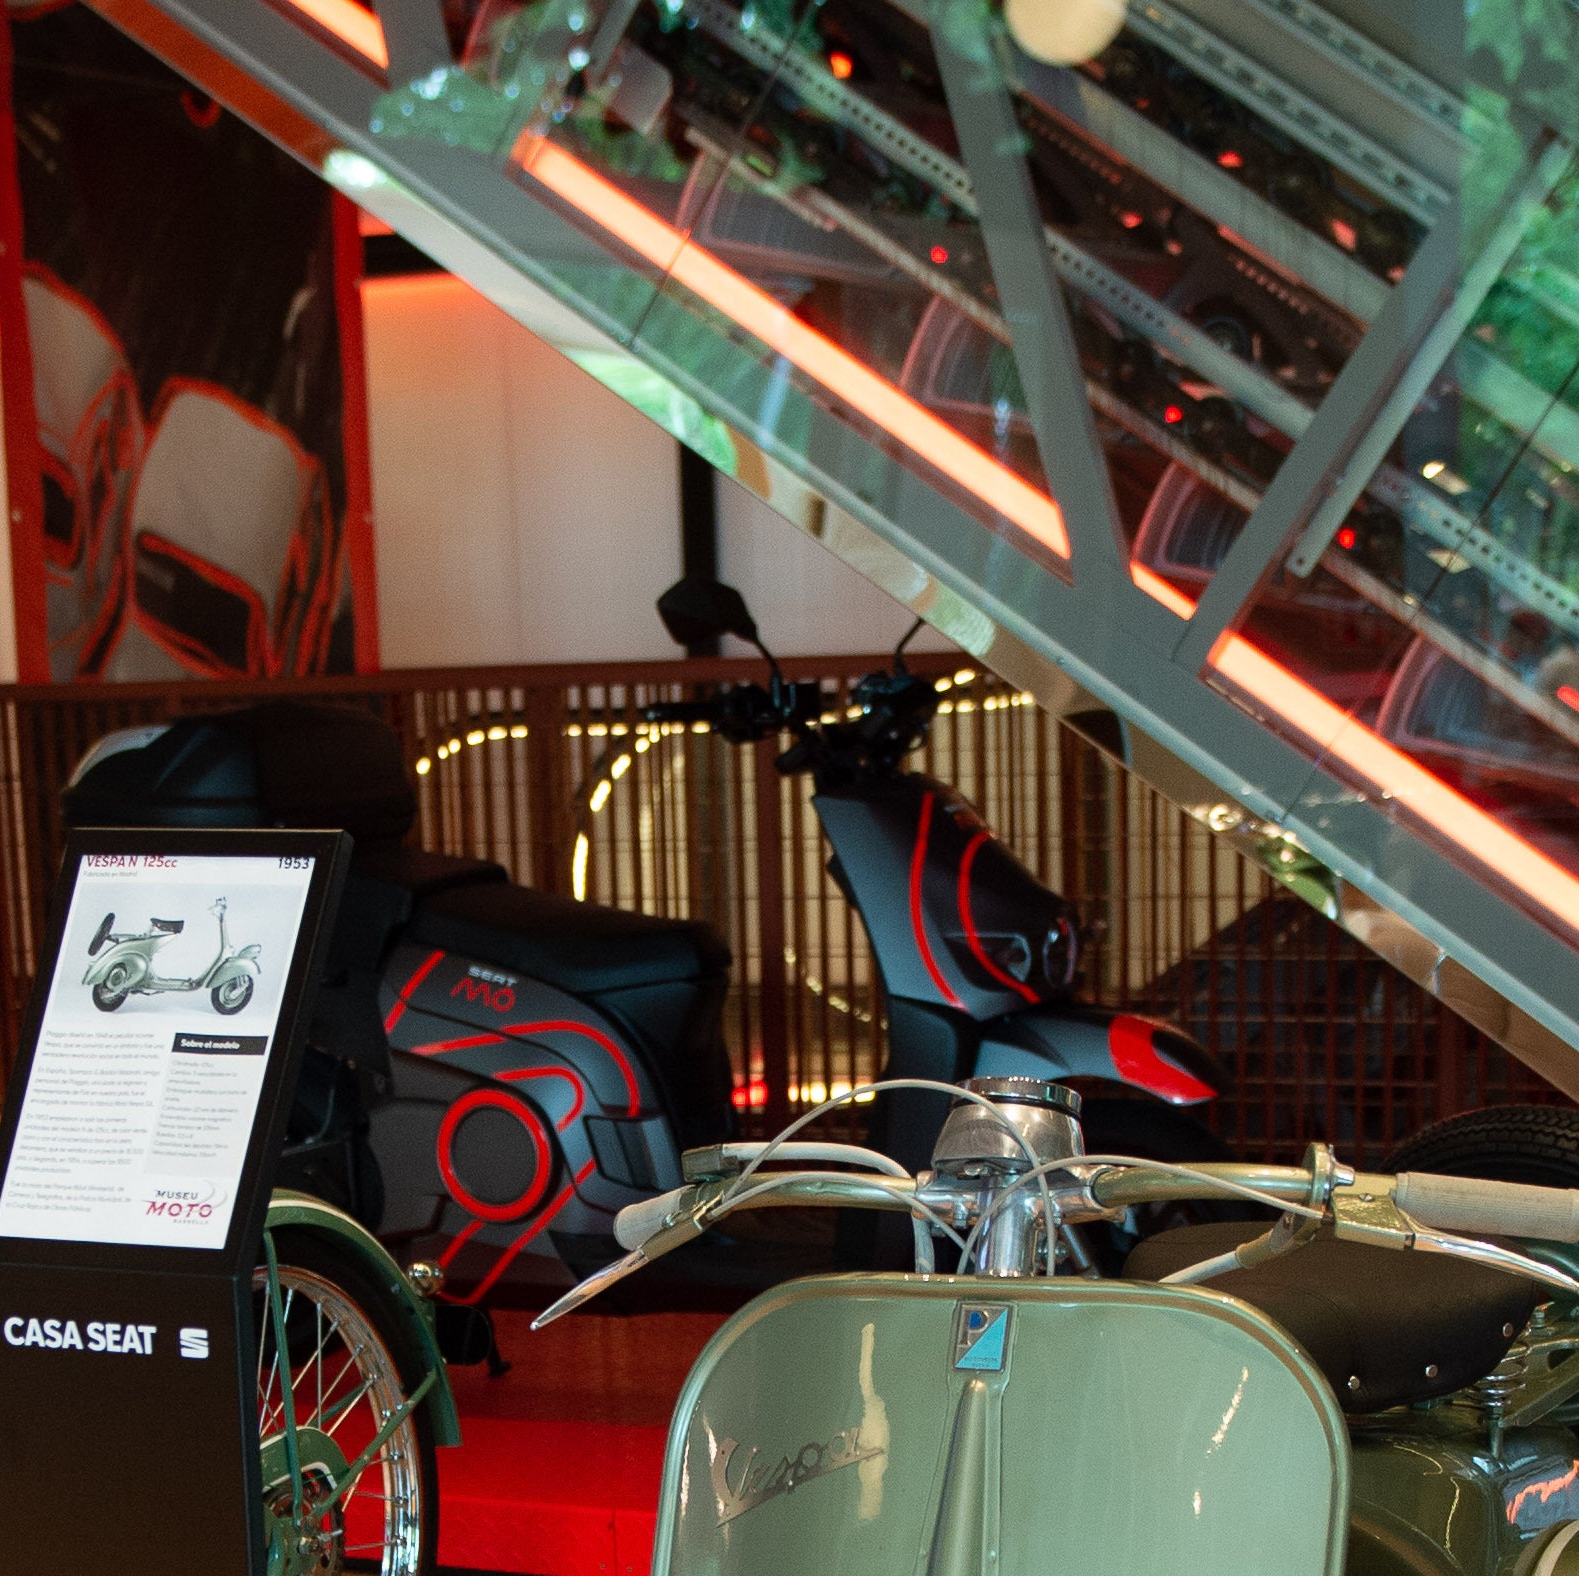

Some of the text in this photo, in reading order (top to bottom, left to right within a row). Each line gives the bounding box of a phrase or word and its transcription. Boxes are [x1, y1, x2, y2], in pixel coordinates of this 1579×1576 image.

[86, 856, 178, 868] VESPA N 125cc
[277, 857, 310, 869] 1953
[468, 965, 517, 987] SEAT
[180, 1038, 240, 1050] Sobre el modelo
[154, 1190, 199, 1200] MUSEU
[143, 1200, 212, 1218] MOTO
[3, 1316, 157, 1355] CASA SEAT
